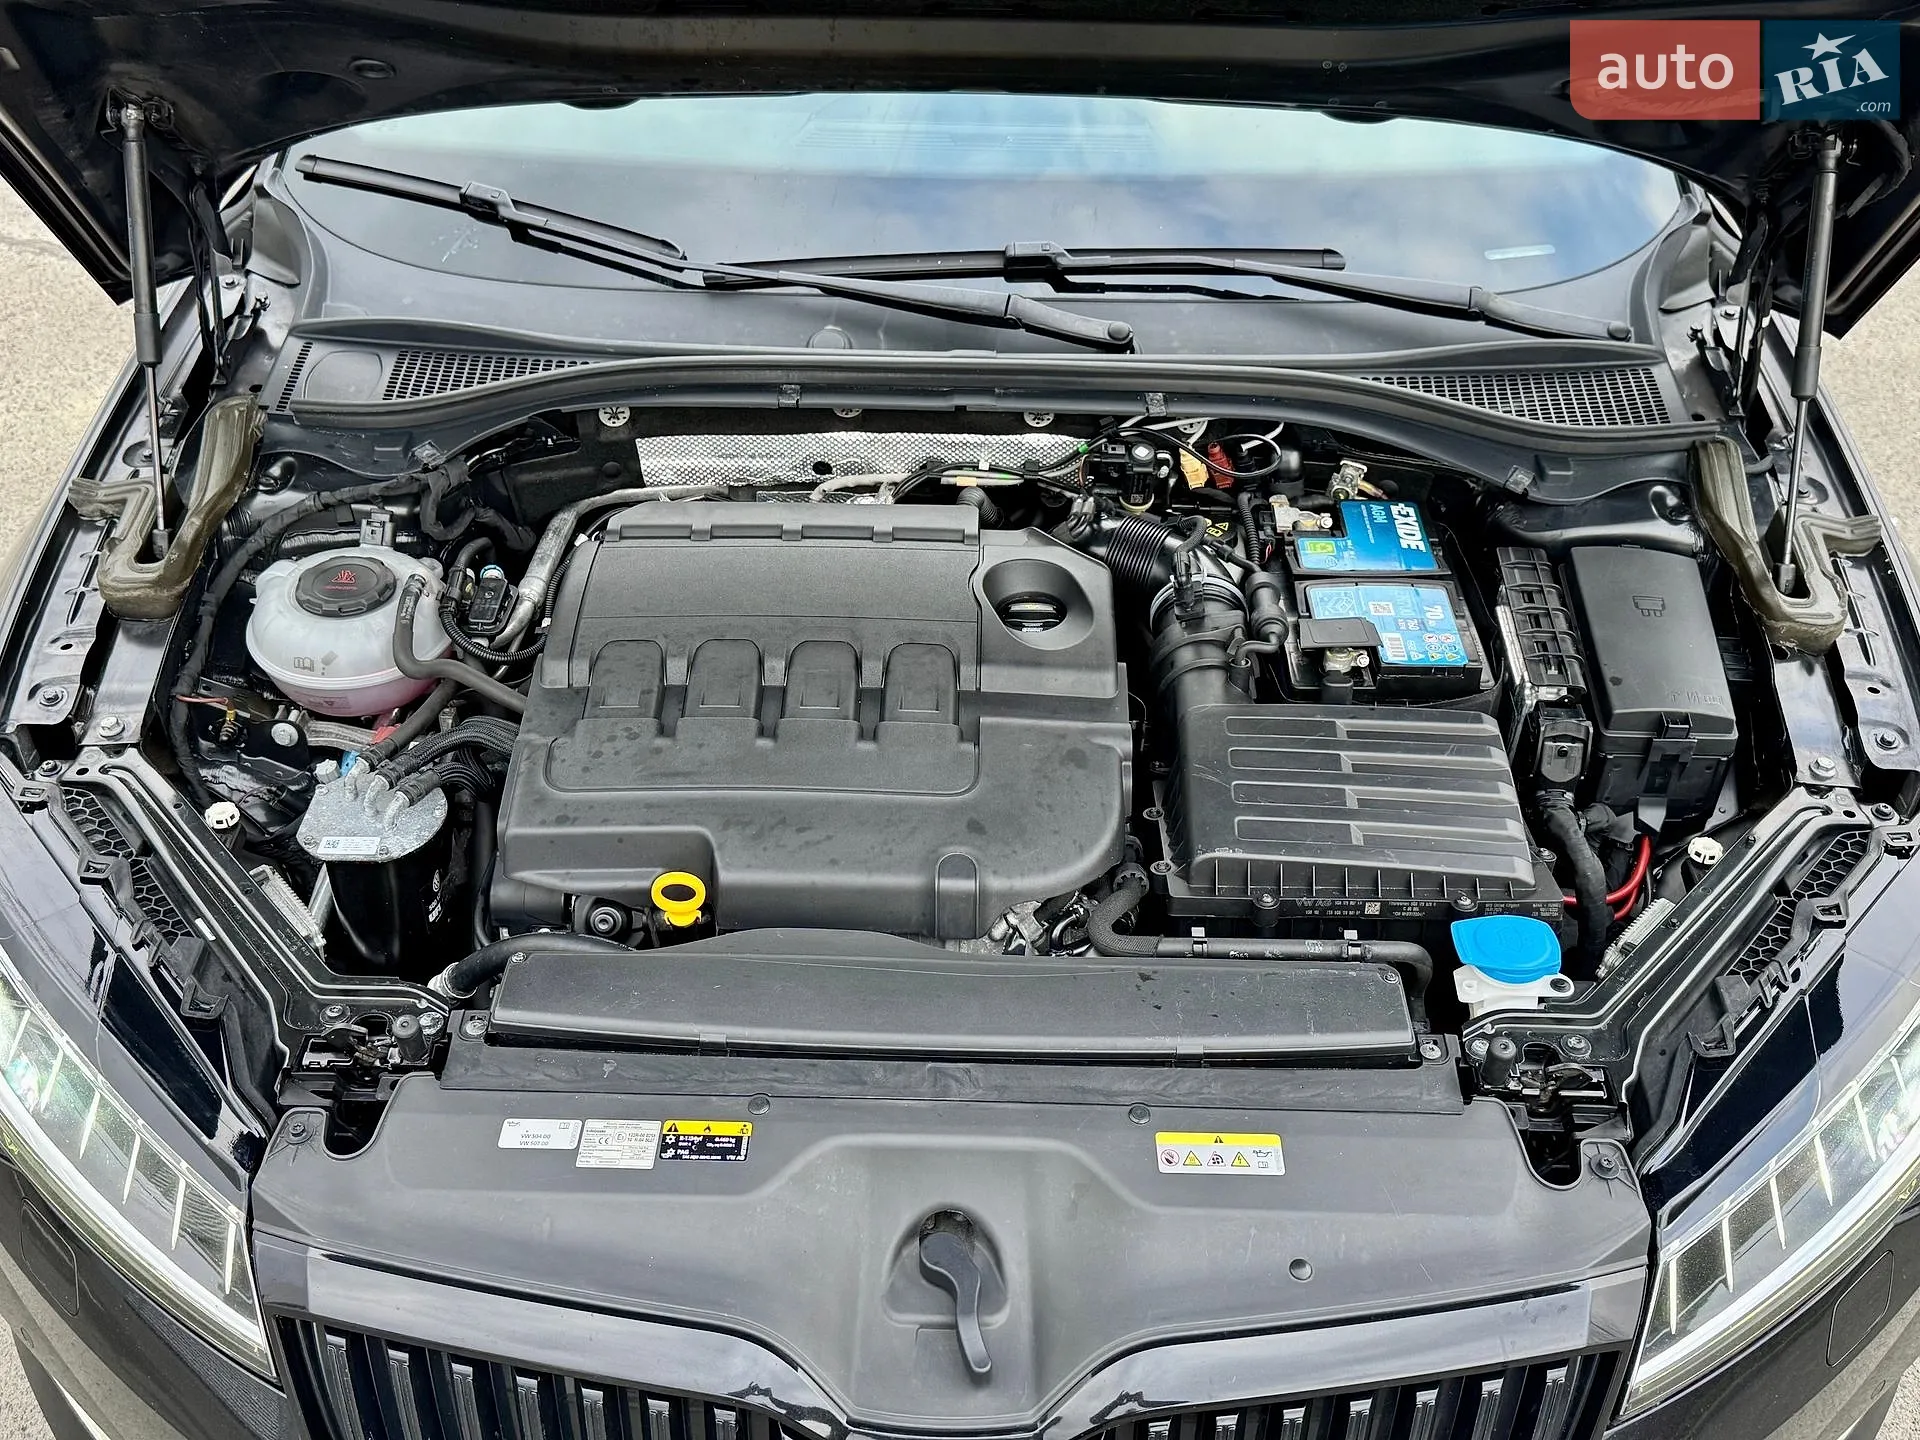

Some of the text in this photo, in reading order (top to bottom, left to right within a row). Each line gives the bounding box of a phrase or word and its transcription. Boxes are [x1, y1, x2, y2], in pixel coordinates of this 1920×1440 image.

[1369, 504, 1388, 524] AGM
[1389, 503, 1426, 552] EXIDE
[1423, 605, 1445, 620] 70
